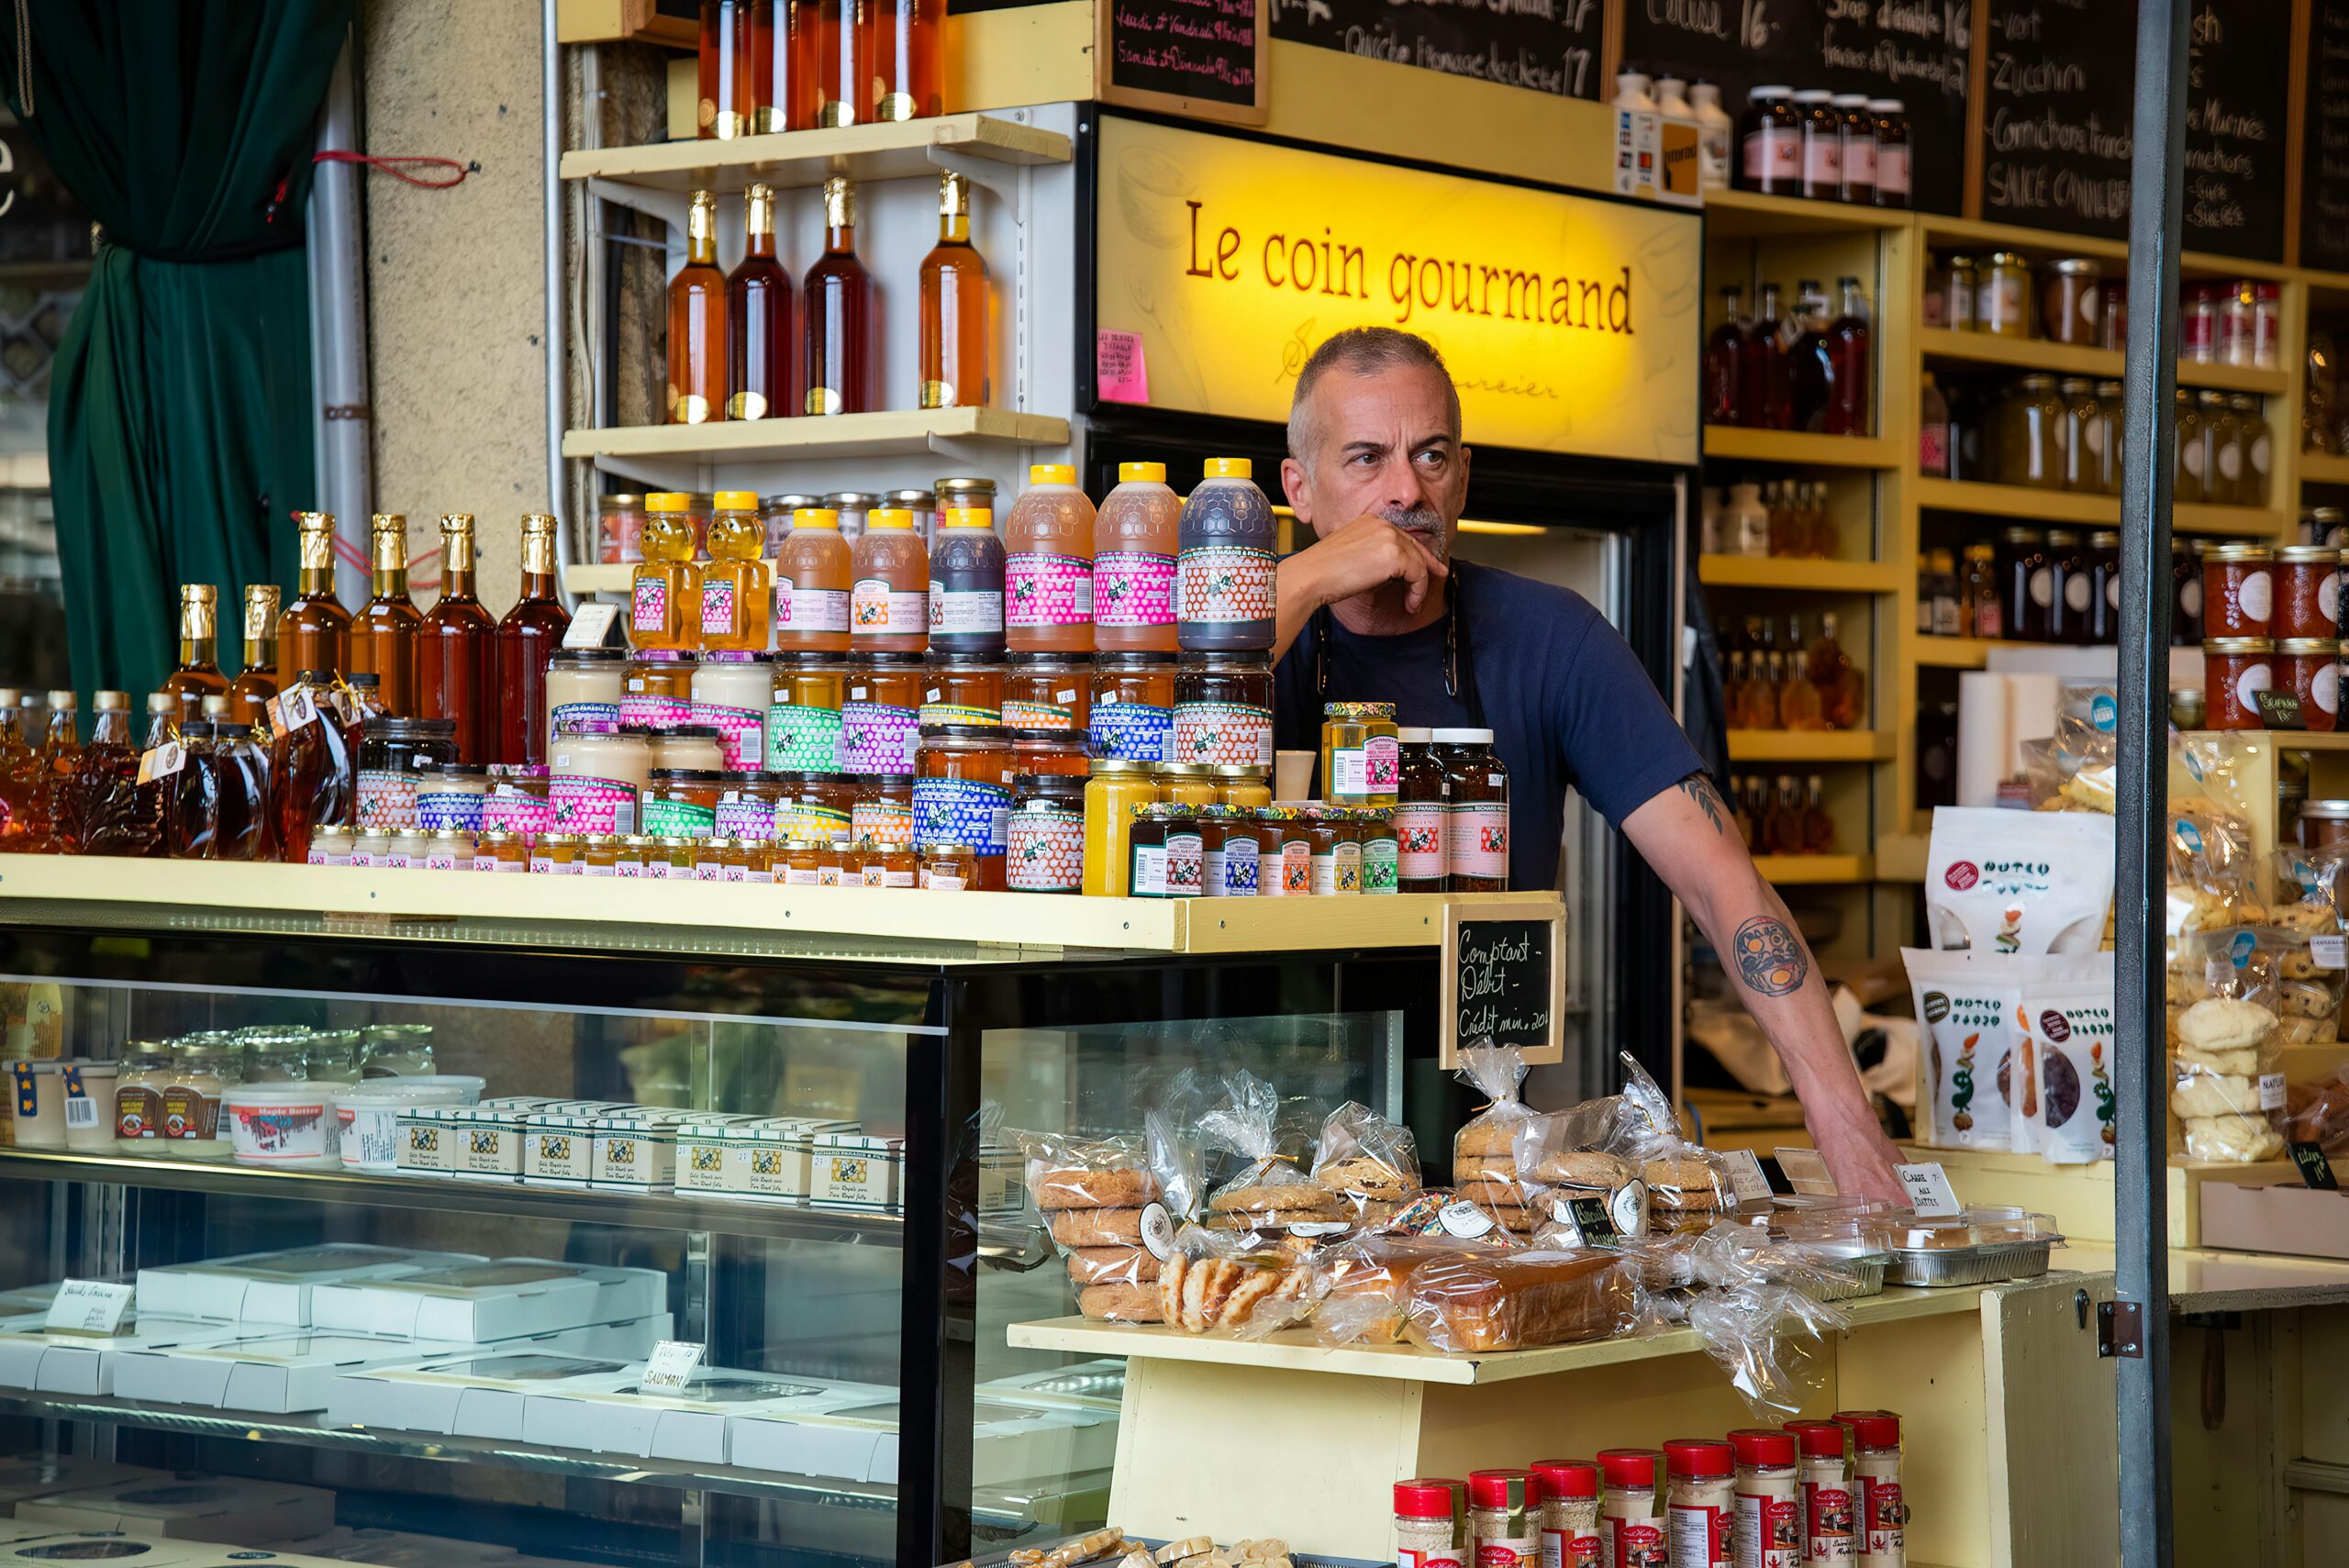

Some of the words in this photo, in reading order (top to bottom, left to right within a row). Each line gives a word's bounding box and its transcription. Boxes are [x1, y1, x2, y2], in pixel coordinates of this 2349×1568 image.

[1186, 200, 1241, 281] Le
[1264, 227, 1369, 300] coin
[1389, 250, 1634, 336] gourmand
[1458, 929, 1531, 977] Comptant
[1461, 965, 1506, 1003] Débit
[1458, 1005, 1498, 1038] Crédit
[259, 1107, 285, 1117] Maple
[288, 1107, 320, 1116] Butter
[644, 1369, 685, 1388] SAUMON
[1490, 1549, 1512, 1562] Hatley
